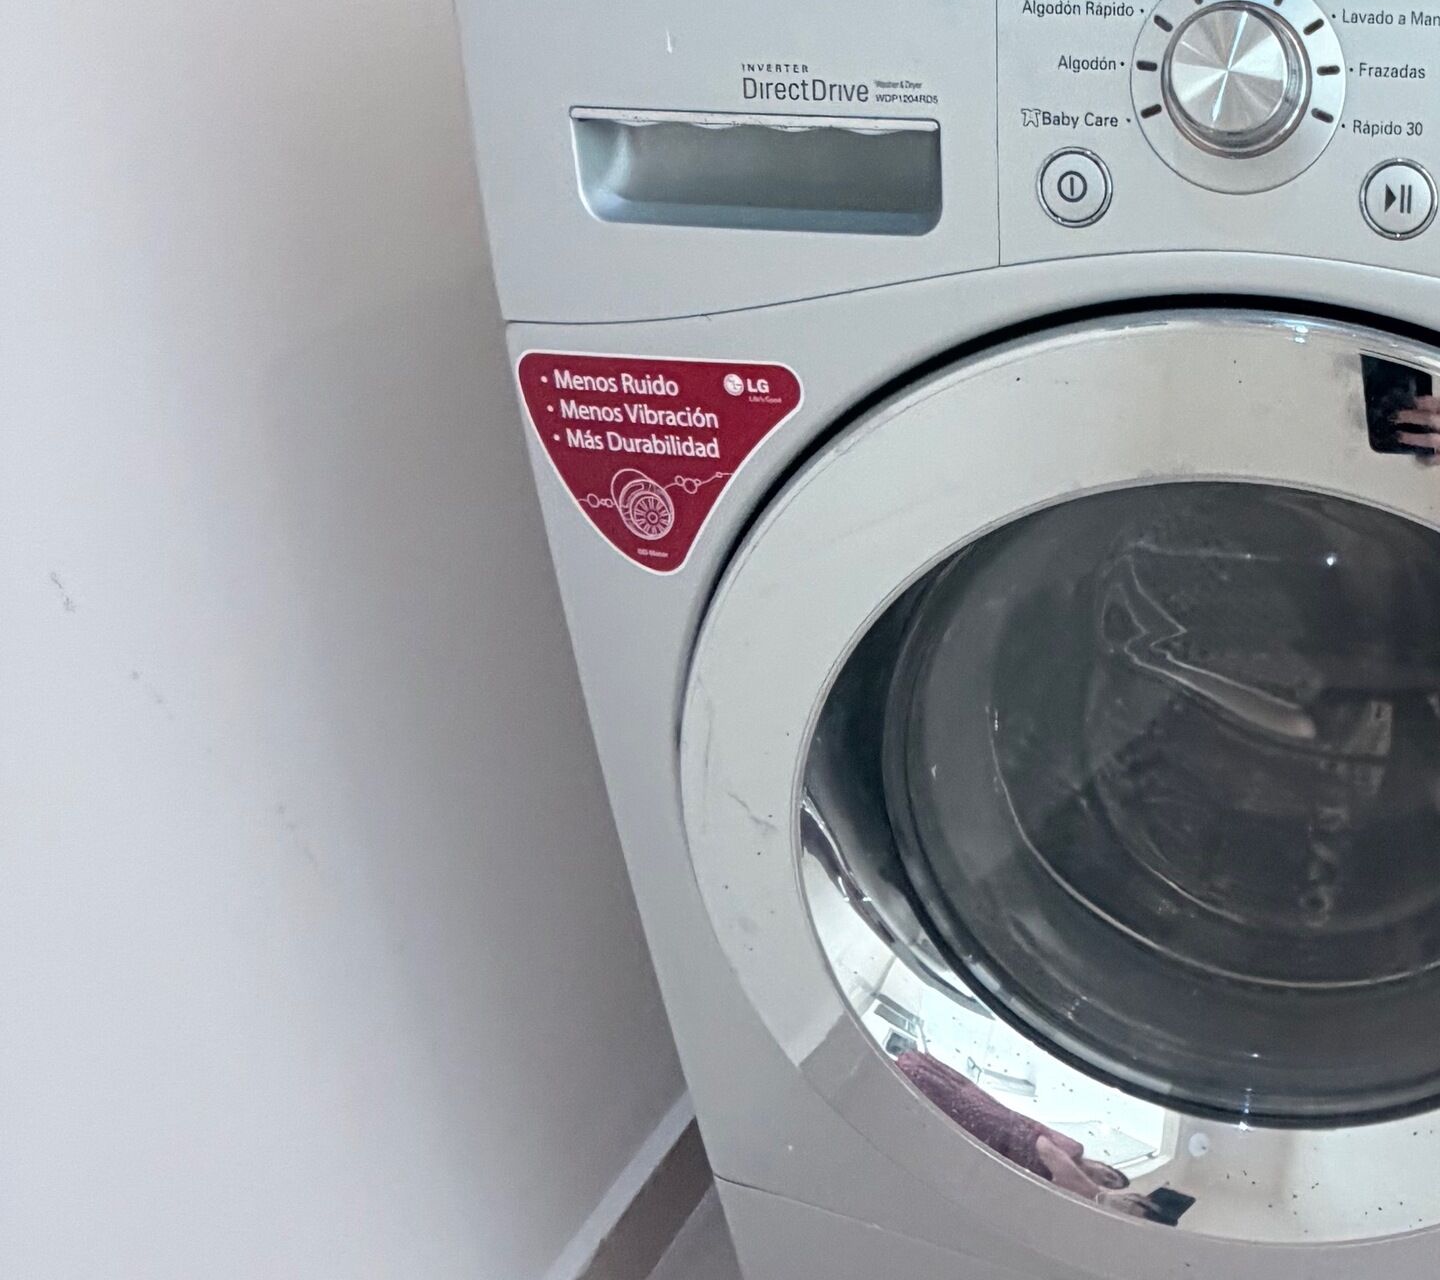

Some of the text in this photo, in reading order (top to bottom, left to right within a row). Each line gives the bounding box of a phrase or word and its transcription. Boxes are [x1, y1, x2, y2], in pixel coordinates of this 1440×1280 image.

[1022, 0, 1134, 20] Algodón Rápido
[1342, 9, 1394, 26] Lavado
[1398, 15, 1407, 26] a
[741, 63, 809, 74] INVERTER
[1057, 55, 1117, 74] Algodón
[1359, 64, 1426, 80] Frazadas
[1042, 111, 1118, 130] Baby Care
[1352, 120, 1423, 138] Rápido 30
[554, 369, 679, 397] Menos Ruido
[747, 378, 770, 394] LG
[560, 399, 719, 429] Menos Vibración
[565, 427, 721, 459] Más Durabilidad
